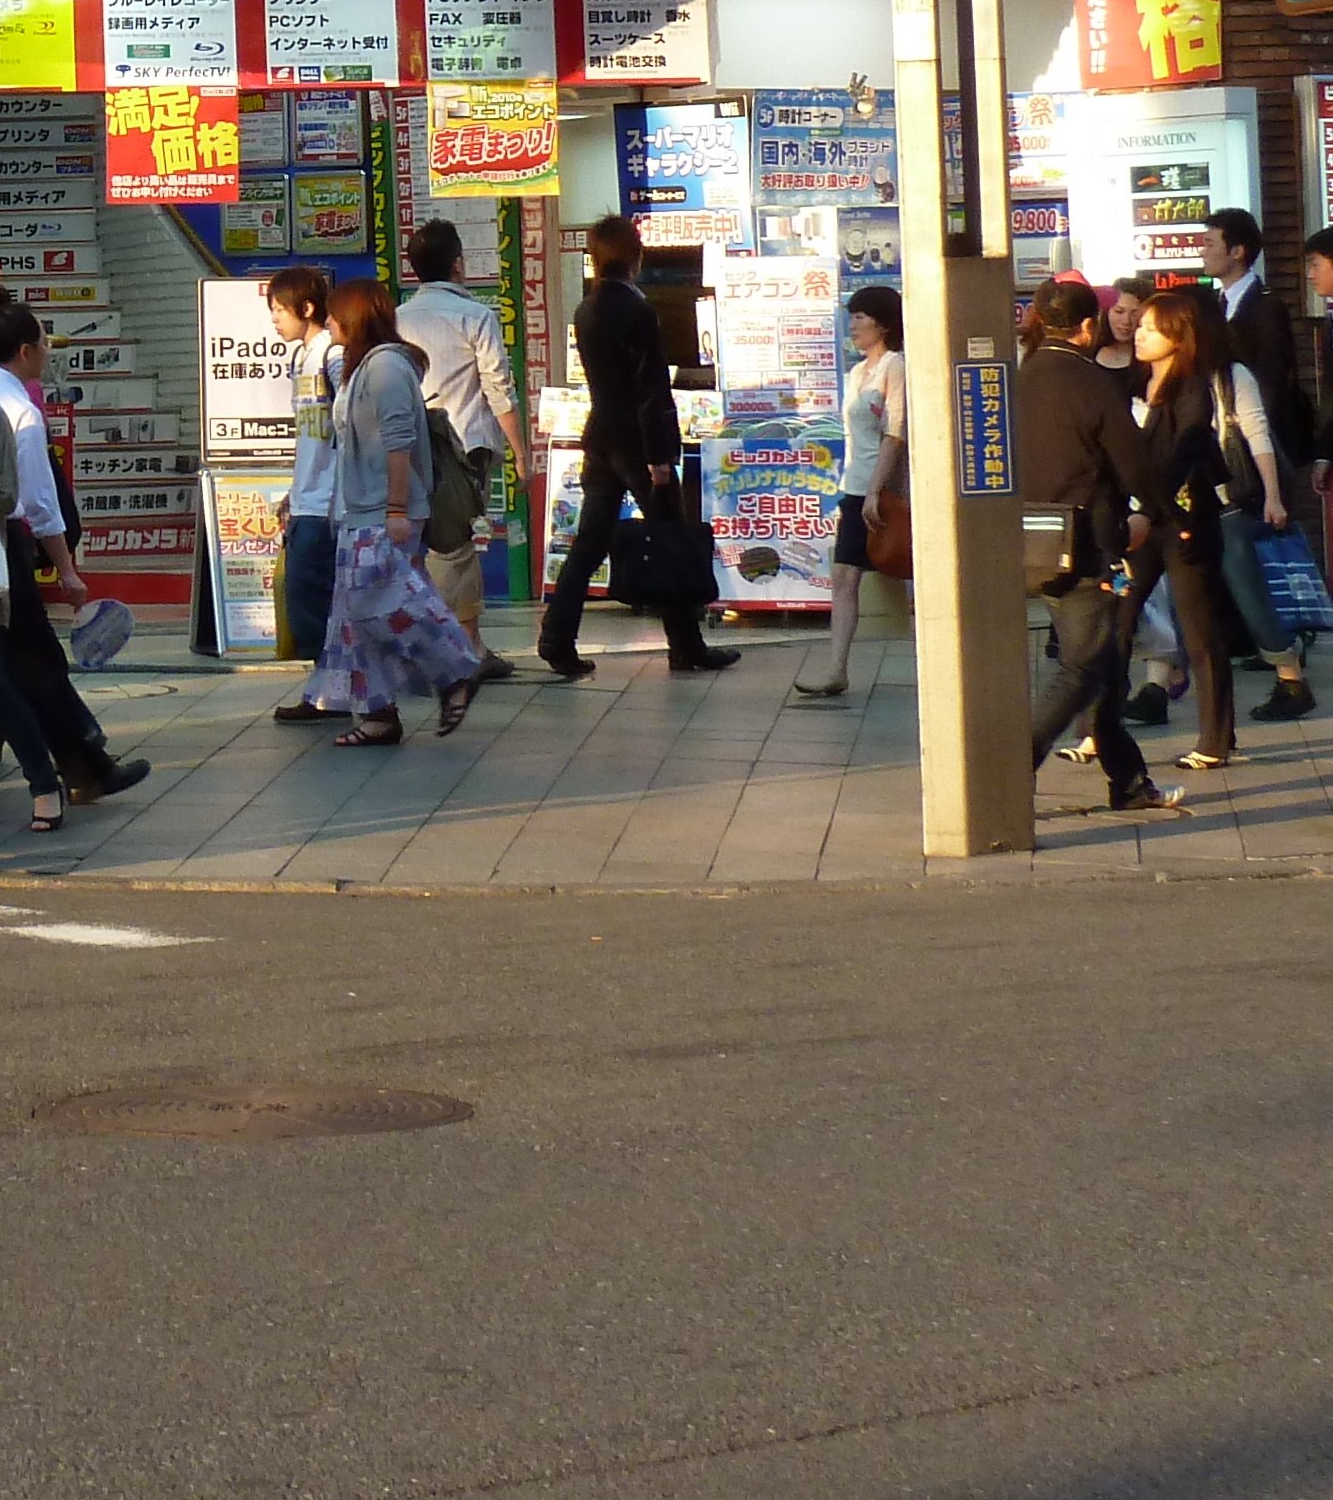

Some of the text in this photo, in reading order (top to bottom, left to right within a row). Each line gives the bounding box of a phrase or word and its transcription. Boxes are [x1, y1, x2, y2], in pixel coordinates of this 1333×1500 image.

[108, 16, 201, 30] 録画用メディア
[269, 14, 329, 27] PCソフト
[429, 12, 522, 26] FAX 変圧器
[587, 9, 690, 23] 目覚し時計 香水
[269, 36, 389, 50] インターネット受付
[430, 35, 507, 48] セキュリティ
[589, 32, 666, 45] スーツケース
[431, 57, 523, 71] 電子辞書 電卓
[589, 55, 667, 69] 時計電池交換
[134, 67, 161, 78] SKY
[105, 86, 200, 136] 満足!
[396, 107, 408, 121] 5F
[471, 103, 555, 121] エコポイント
[778, 108, 838, 124] 時計コーナー
[1028, 97, 1053, 125] 祭
[397, 131, 409, 145] 4F
[626, 124, 734, 150] スーパーマリオ
[1117, 132, 1197, 149] INFORMATION
[150, 121, 239, 176] 価格
[431, 121, 555, 169] 家電まつり!
[397, 156, 410, 171] 3F
[627, 151, 739, 178] ギャラクシー2
[111, 175, 236, 186] 他店より高い品は販売員まで
[111, 187, 213, 198] ぜひお申し付けください
[399, 208, 412, 221] 1F
[724, 270, 831, 299] エアコン 祭
[210, 336, 287, 359] iPadの
[216, 423, 240, 437] 3F
[980, 367, 1005, 489] 防犯カメラ作動中
[729, 450, 815, 465] ビックカメラ
[80, 457, 162, 473] キッチン家電
[217, 491, 263, 505] ドリーム
[217, 505, 268, 517] ジャンボ
[738, 495, 821, 517] ご自由に
[219, 517, 277, 538] 宝くじ
[220, 540, 280, 556] プレゼント
